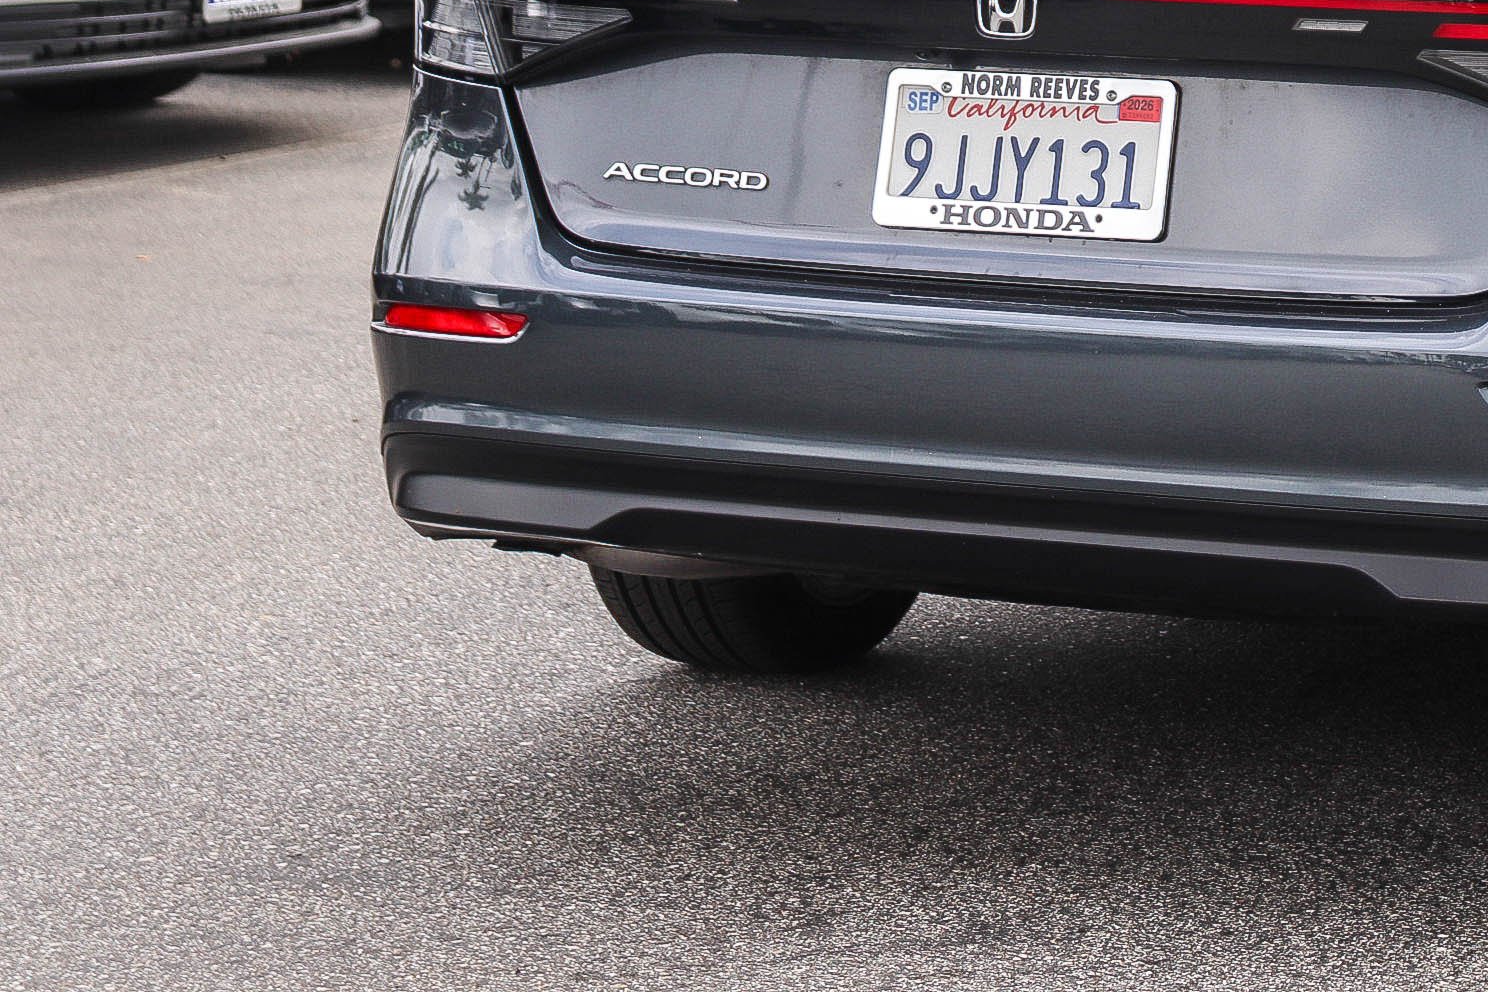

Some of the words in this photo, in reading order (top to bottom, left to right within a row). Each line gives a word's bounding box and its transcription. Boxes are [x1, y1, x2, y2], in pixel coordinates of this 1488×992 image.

[907, 90, 939, 112] SEP
[961, 73, 1021, 97] NORM
[1029, 76, 1101, 101] REEVES
[946, 96, 1118, 131] California
[1127, 98, 1154, 111] 2026
[602, 161, 770, 192] ACCORD
[900, 132, 1141, 210] 9JJY131
[939, 203, 1095, 233] HONDA
